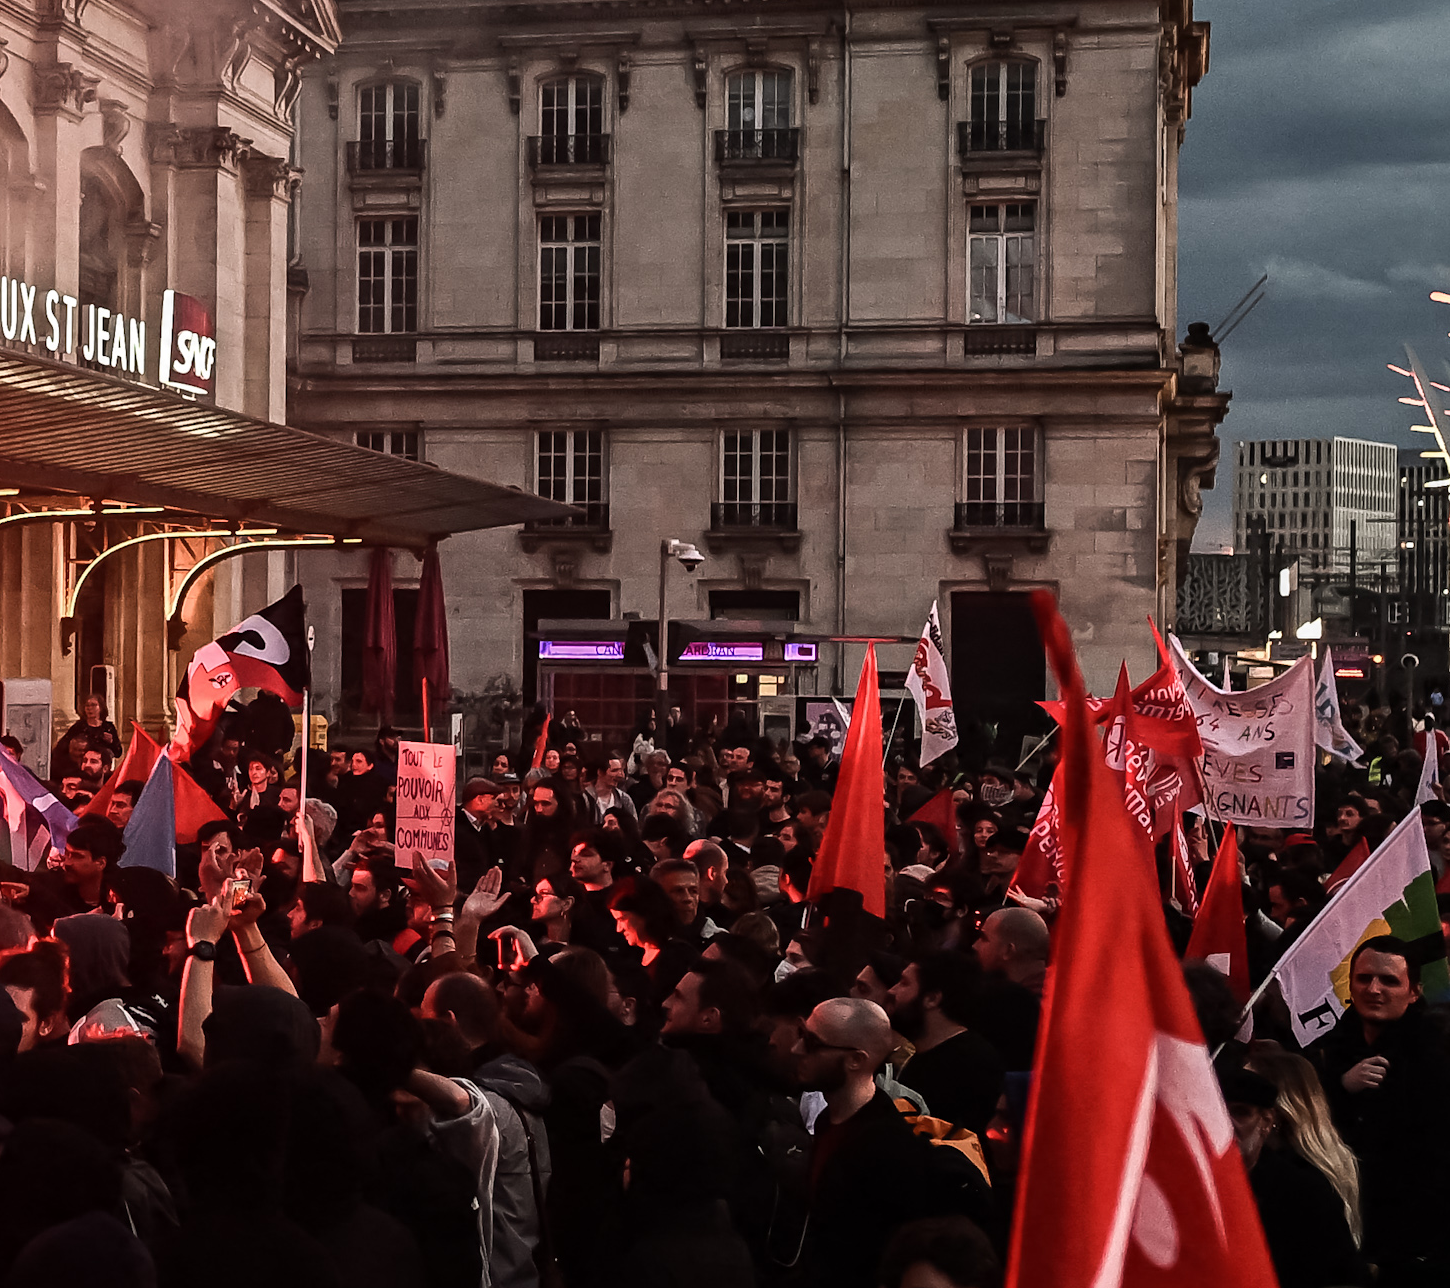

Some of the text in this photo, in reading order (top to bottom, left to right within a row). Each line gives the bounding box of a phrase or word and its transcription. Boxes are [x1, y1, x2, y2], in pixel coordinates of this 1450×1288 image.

[45, 289, 77, 355] ST
[82, 304, 146, 376] JEAN
[172, 328, 216, 381] SNCF
[1238, 721, 1275, 741] ANS
[402, 749, 443, 768] TOUT LE
[397, 827, 449, 851] COMMUNES
